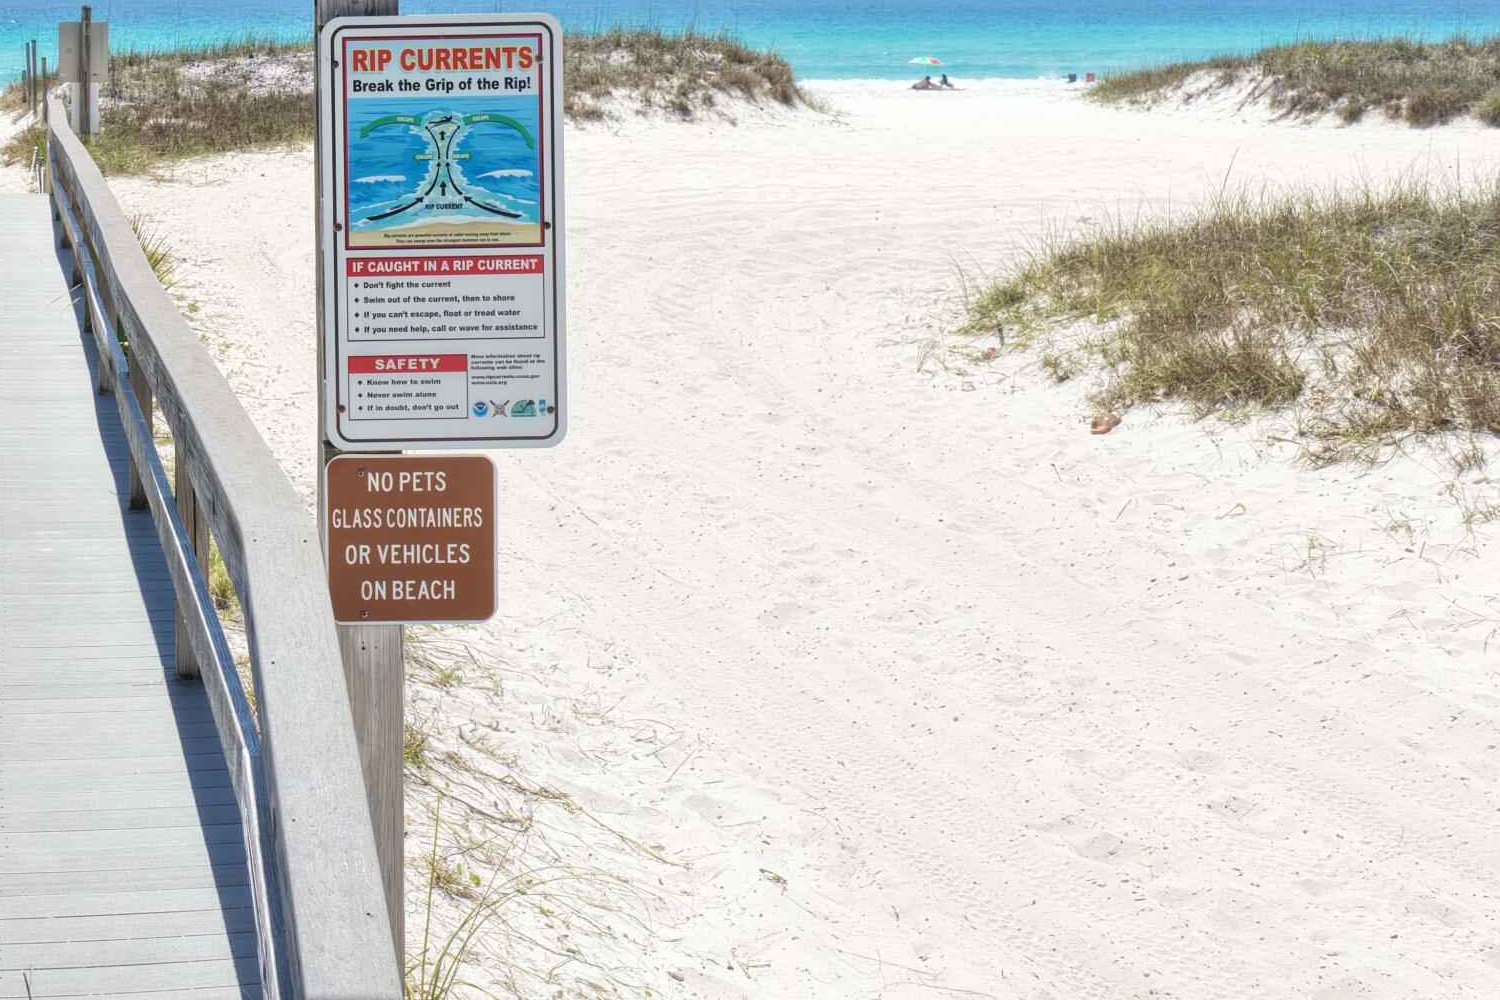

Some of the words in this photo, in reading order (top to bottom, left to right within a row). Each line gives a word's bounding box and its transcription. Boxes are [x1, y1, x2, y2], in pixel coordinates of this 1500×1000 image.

[352, 49, 392, 72] RIP
[400, 46, 533, 72] CURRENTS
[353, 79, 394, 92] Break
[398, 79, 421, 92] the
[425, 78, 454, 94] Grip
[458, 77, 472, 90] of
[477, 77, 500, 90] the
[504, 76, 531, 92] Rip!
[353, 262, 364, 272] IF
[368, 261, 420, 272] CAUGHT
[424, 260, 437, 271] IN
[440, 260, 450, 271] A
[453, 260, 474, 271] RIP
[477, 259, 538, 270] CURRENT
[363, 281, 384, 289] Don't
[386, 281, 404, 290] fight
[375, 358, 440, 370] SAFETY
[368, 472, 393, 492] NO
[399, 471, 446, 492] PETS
[332, 508, 382, 528] GLASS
[386, 507, 483, 528] CONTAINERS
[345, 545, 370, 565] OR
[377, 543, 470, 564] VEHICLES
[361, 580, 386, 600] ON
[392, 580, 455, 600] BEACH
